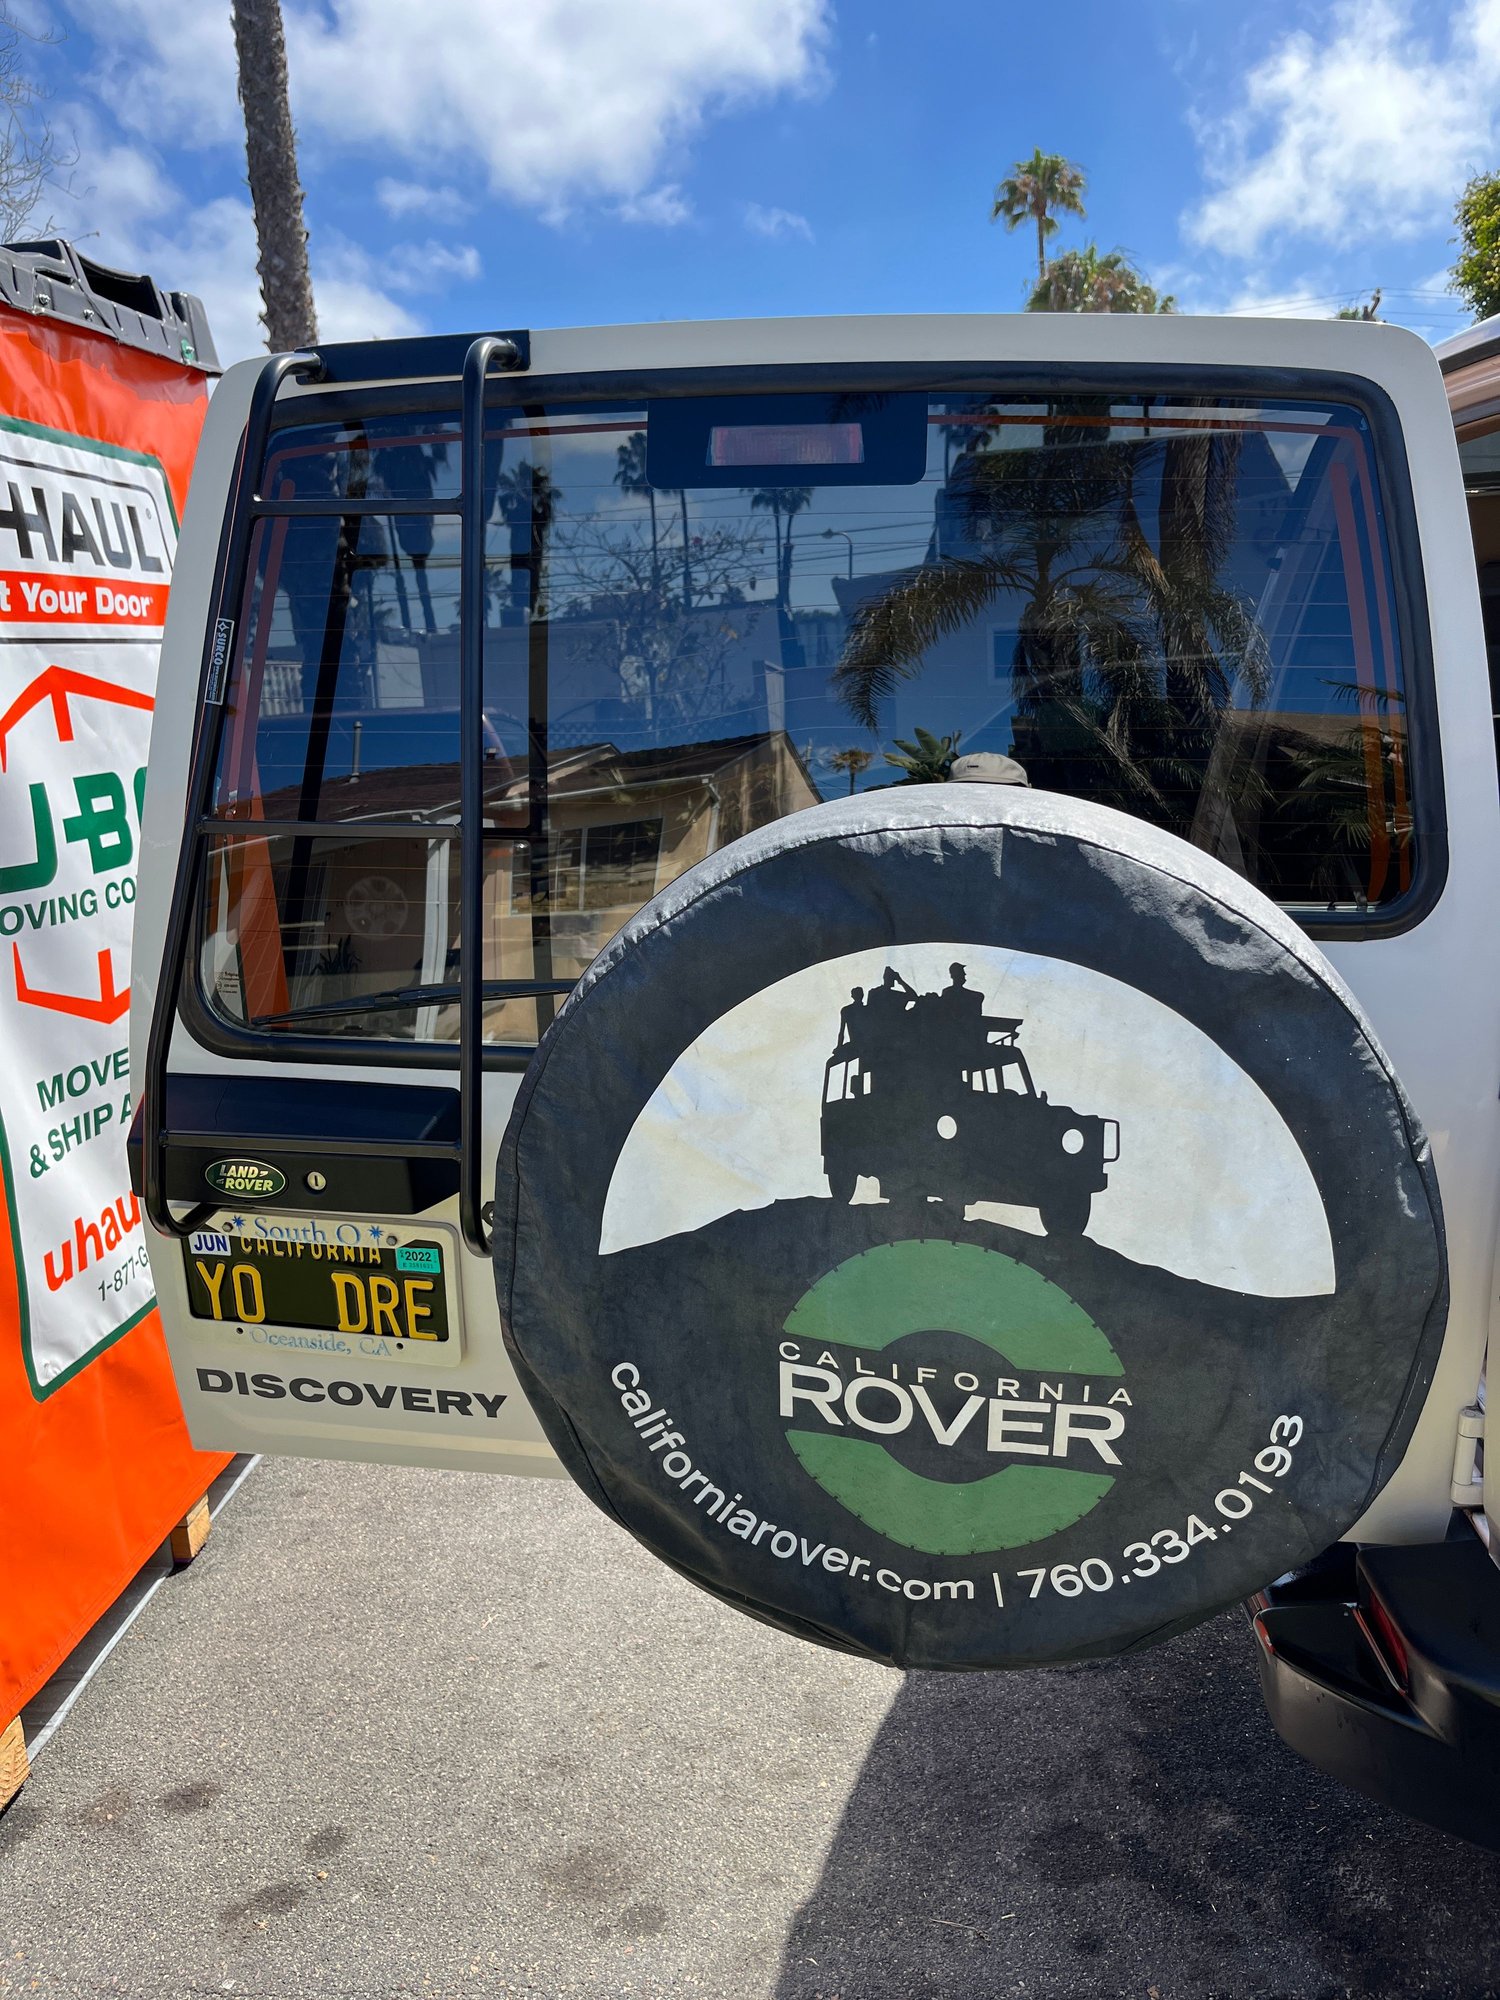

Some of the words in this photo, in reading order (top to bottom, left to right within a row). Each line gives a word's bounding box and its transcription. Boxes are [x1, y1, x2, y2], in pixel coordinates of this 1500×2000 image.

[20, 582, 87, 614] Your
[95, 587, 150, 617] Door
[213, 632, 227, 666] SURCO
[36, 1047, 130, 1112] MOVE
[30, 1144, 50, 1179] &
[48, 1102, 113, 1162] SHIP
[219, 1164, 259, 1179] LAND
[224, 1178, 273, 1192] ROVER
[43, 1190, 142, 1292] uhau
[194, 1234, 229, 1253] JUN
[254, 1216, 327, 1244] South
[336, 1223, 362, 1246] O
[239, 1236, 382, 1264] CALIFORNIA
[405, 1251, 432, 1262] 2022
[331, 1272, 438, 1341] DRE
[250, 1326, 352, 1355] Oceanside,
[359, 1336, 393, 1357] CA
[778, 1341, 1133, 1407] CALIFORNIA
[195, 1367, 508, 1419] DISCOVERY
[779, 1360, 1123, 1466] ROVER
[611, 1361, 975, 1600] californiarover.com
[1016, 1414, 1304, 1598] 760.334.0193
